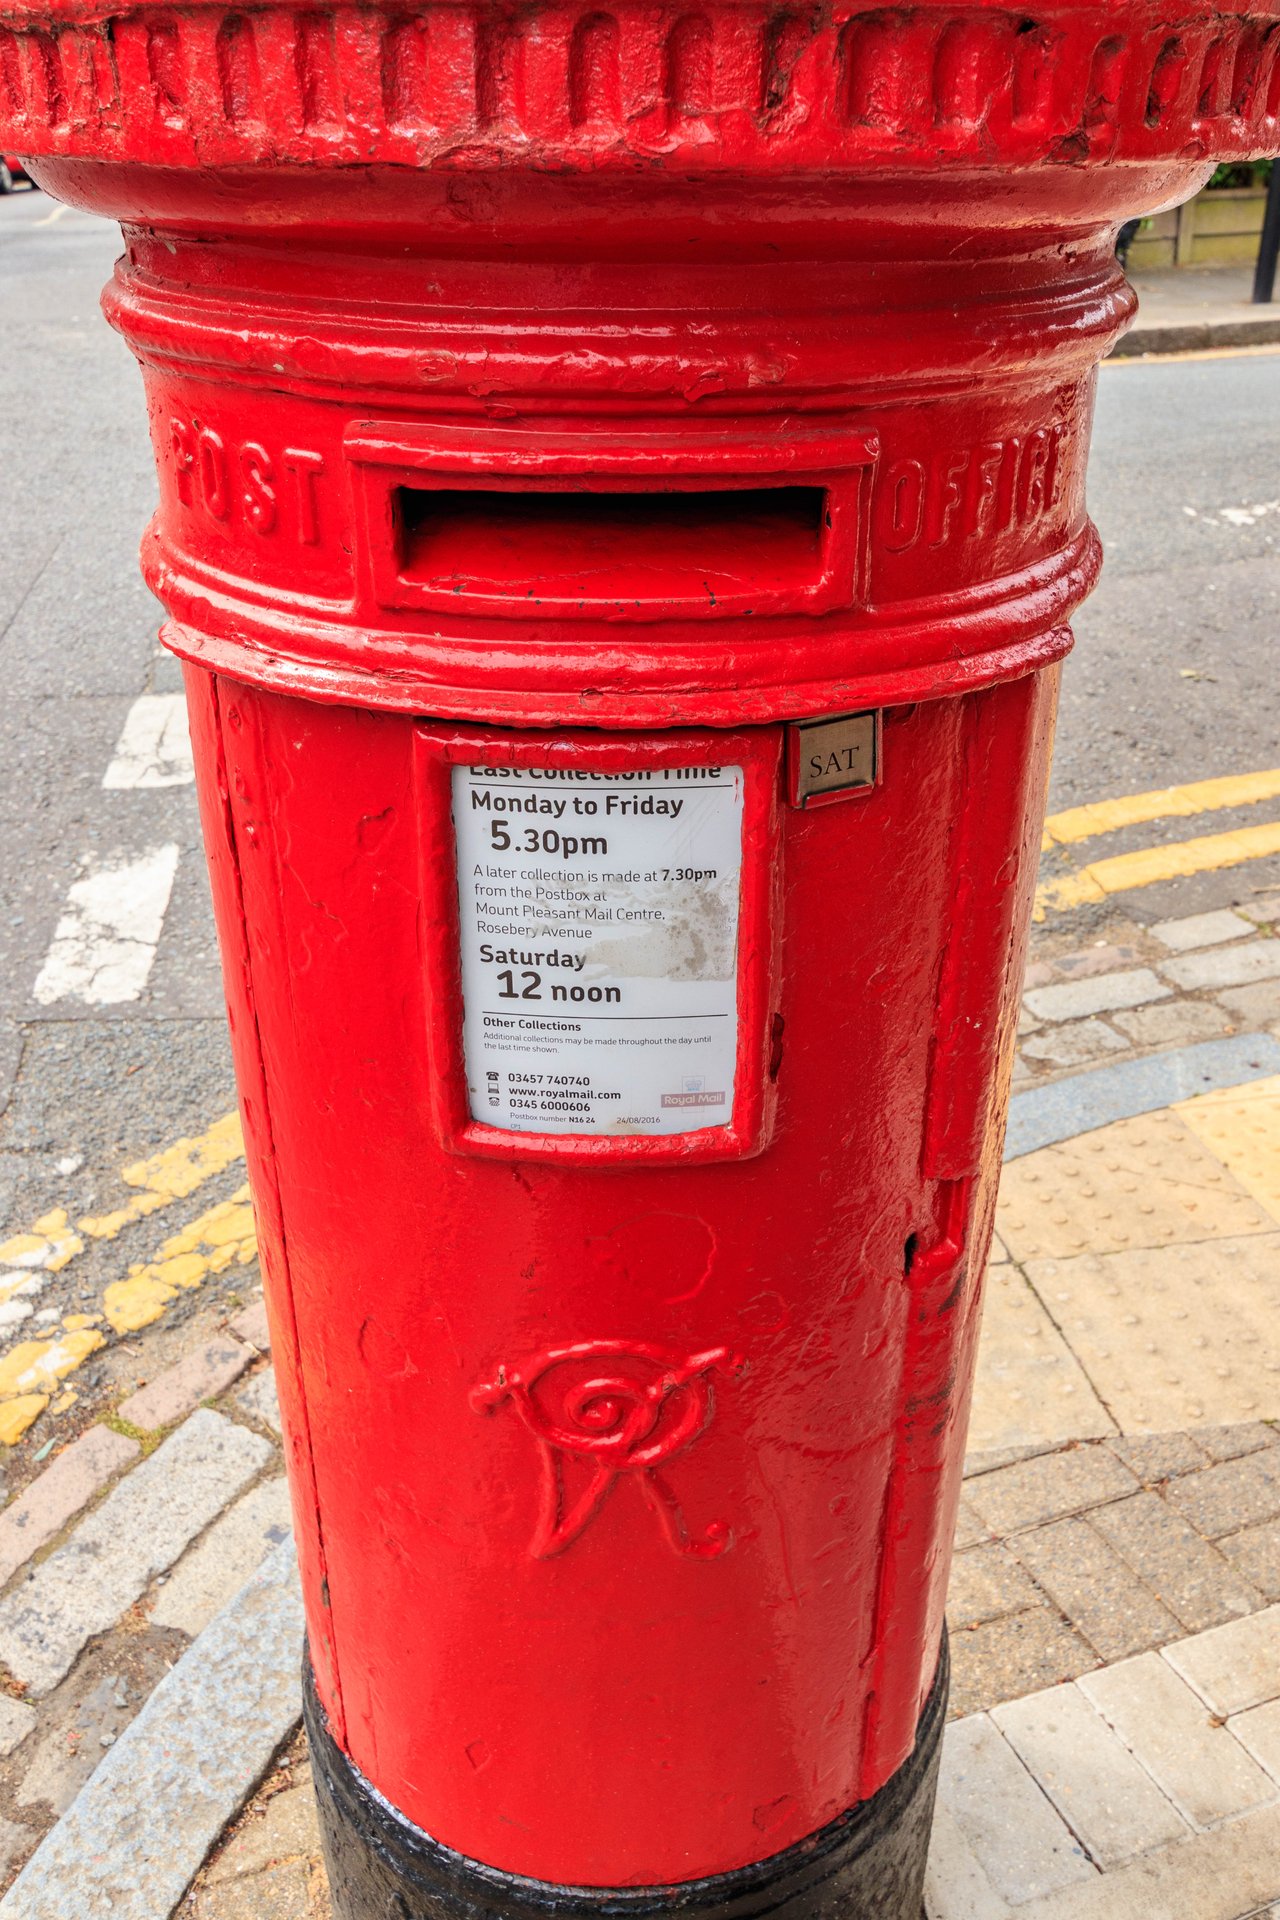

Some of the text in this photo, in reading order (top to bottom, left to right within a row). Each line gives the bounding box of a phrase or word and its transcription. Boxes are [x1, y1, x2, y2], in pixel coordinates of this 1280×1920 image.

[170, 416, 325, 547] POST
[810, 746, 860, 778] SAT
[471, 790, 684, 819] Monday to Friday
[491, 819, 608, 859] 5.30pm
[473, 864, 717, 883] A later collection is made at 7.30pm
[475, 883, 607, 901] from the Postbox at
[476, 902, 665, 920] Mount Pleasant Mail Centre.
[477, 920, 593, 939] Rosebery Avenue
[480, 944, 587, 972] Saturday
[497, 969, 622, 1003] 12 noon
[483, 1017, 582, 1031] Other Collections
[483, 1031, 712, 1047] Additional collections may be made throughout the day until
[484, 1042, 560, 1053] the last time shown.
[508, 1073, 590, 1086] 03457 740740
[508, 1087, 621, 1100] www.royalmail.com
[664, 1094, 722, 1106] Royal Mail
[509, 1098, 590, 1112] 0345 6000606
[510, 1112, 537, 1121] Postbox
[539, 1115, 566, 1123] number
[616, 1116, 661, 1125] 24/08/2016
